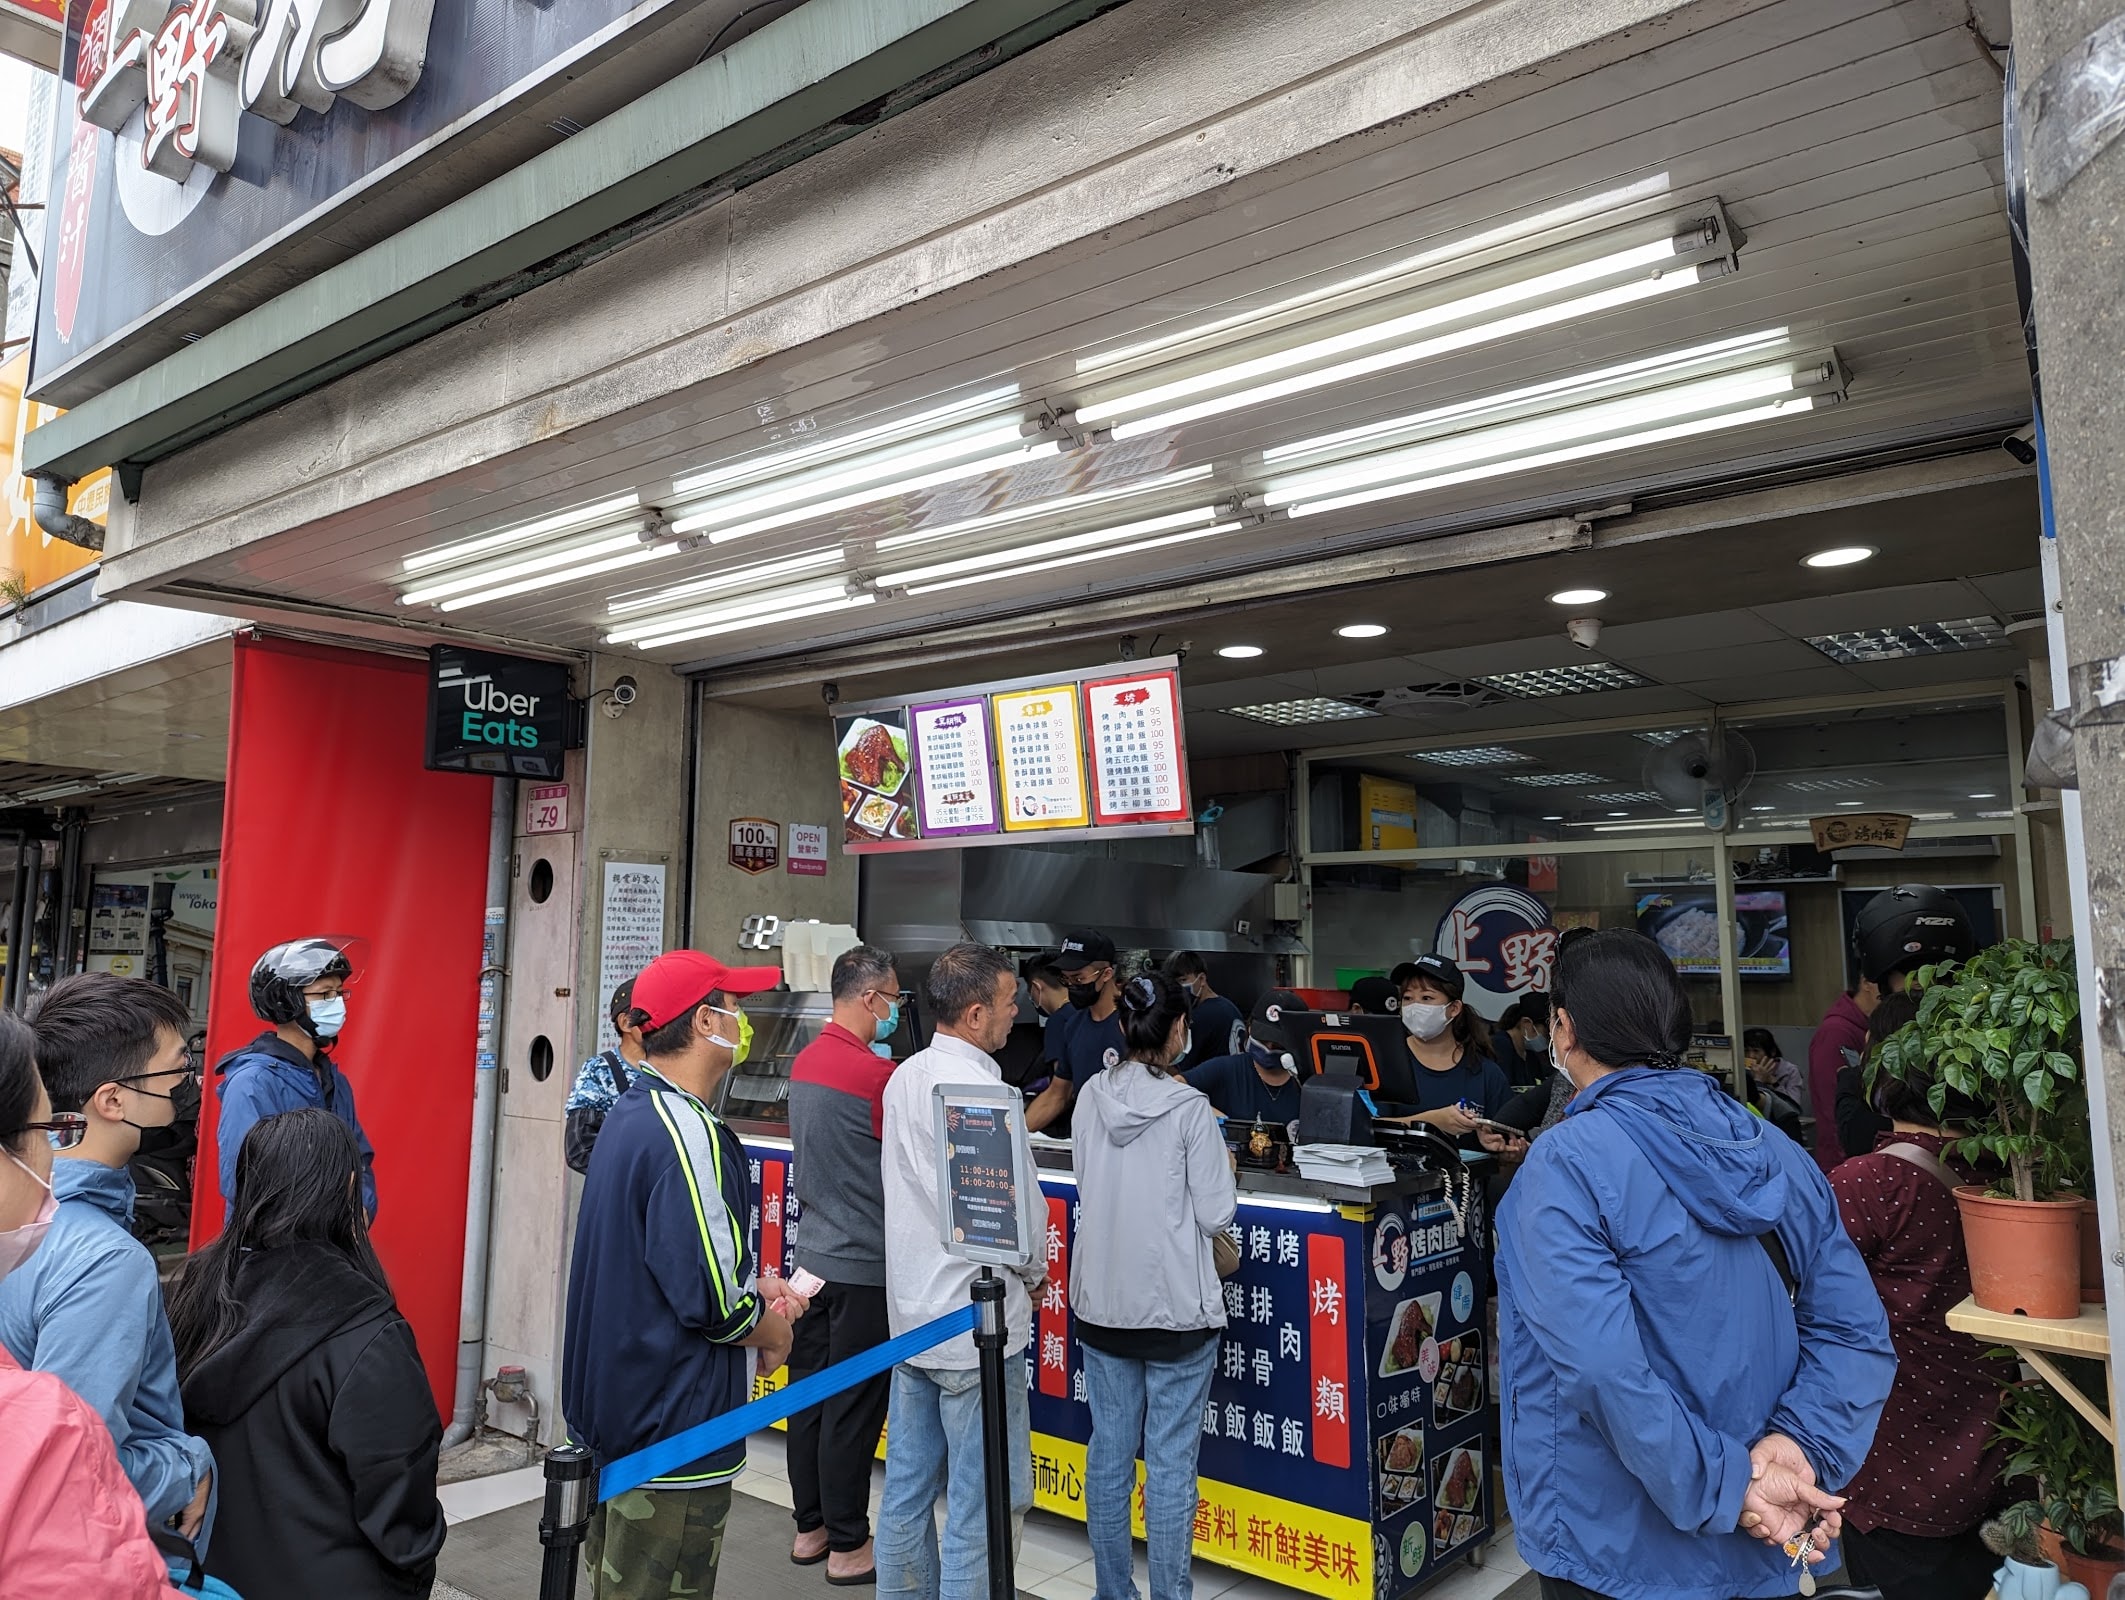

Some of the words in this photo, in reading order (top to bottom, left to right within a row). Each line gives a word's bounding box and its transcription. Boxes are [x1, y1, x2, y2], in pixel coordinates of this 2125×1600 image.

[58, 6, 109, 275] 獨醬汁
[464, 679, 541, 717] Uber
[1102, 709, 1144, 721] 烤肉飯
[1150, 707, 1161, 716] 95
[462, 711, 539, 748] Eats
[1054, 718, 1063, 728] 95
[1102, 720, 1145, 732] 烤排骨飯
[1150, 718, 1162, 726] 95
[967, 729, 976, 738] 95
[1055, 730, 1064, 739] 95
[1103, 732, 1146, 743] 烤雞排飯
[1151, 730, 1164, 738] 100
[967, 739, 978, 748] 100
[1054, 742, 1067, 751] 100
[1104, 743, 1147, 755] 烤雞柳飯
[1153, 741, 1164, 750] 95
[969, 749, 978, 758] 95
[1057, 754, 1067, 762] 95
[1105, 754, 1148, 765] 烤五花肉飯
[1154, 752, 1165, 761] 95
[969, 759, 980, 768] 100
[1056, 765, 1069, 774] 100
[1154, 763, 1167, 772] 100
[970, 769, 982, 778] 100
[971, 779, 983, 787] 100
[1057, 777, 1070, 786] 100
[1107, 776, 1150, 788] 烤雞腿飯
[1155, 775, 1168, 783] 100
[1156, 786, 1169, 795] 100
[1109, 799, 1152, 810] 烤牛柳飯
[1157, 798, 1170, 807] 100
[797, 832, 821, 843] OPEN
[735, 845, 775, 859] 國產雞肉
[797, 844, 819, 855] 營業中
[612, 873, 660, 885] 親愛的客人
[1915, 916, 1956, 927] MZR
[1453, 910, 1557, 992] 上野
[960, 1165, 1008, 1178] 11:00-14:00
[960, 1177, 1009, 1190] 16:00-20:00
[1410, 1220, 1459, 1260] 烤肉飯
[1372, 1227, 1408, 1273] 上野
[1042, 1223, 1065, 1372] 香酥類
[1249, 1225, 1276, 1450] 烤排骨飯
[1277, 1229, 1305, 1457] 烤肉飯
[1312, 1277, 1346, 1424] 烤類
[1420, 1348, 1437, 1377] 美味
[1376, 1386, 1421, 1419] 口味獨特
[1247, 1512, 1362, 1588] 新鮮美味
